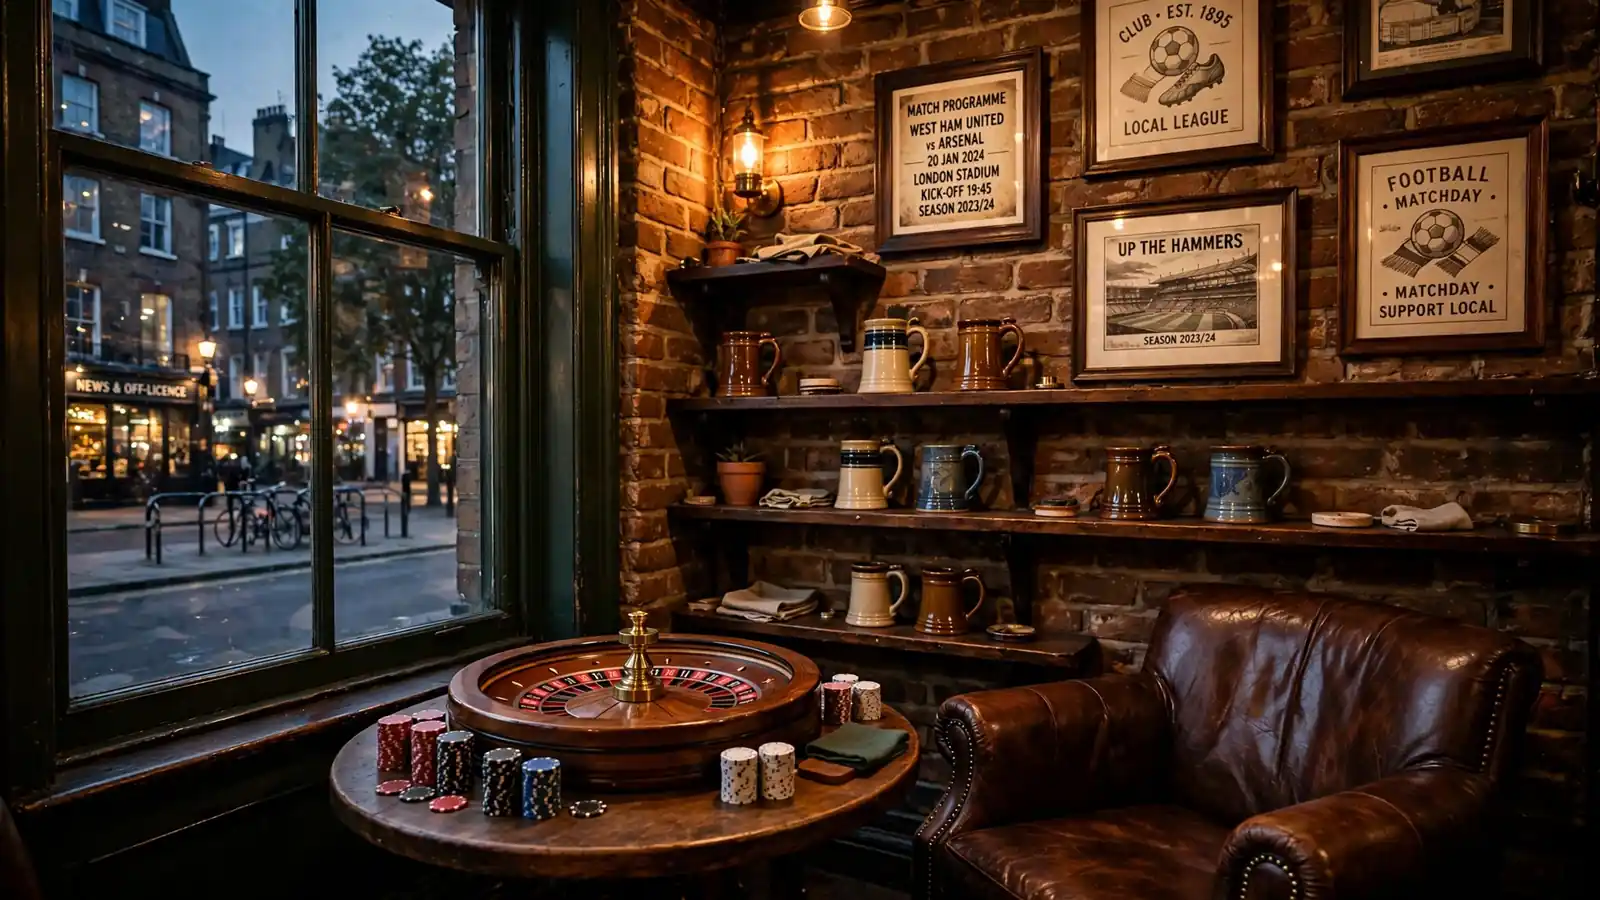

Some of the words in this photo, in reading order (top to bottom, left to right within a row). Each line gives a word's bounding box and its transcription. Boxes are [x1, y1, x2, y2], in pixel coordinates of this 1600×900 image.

[1119, 13, 1152, 43] CLUB
[1168, 4, 1194, 19] EST.
[1200, 5, 1233, 28] 1895
[908, 101, 939, 117] MATCH
[943, 92, 1006, 112] PROGRAMME
[910, 122, 936, 136] WEST
[940, 119, 962, 132] HAM
[967, 113, 1004, 129] UNITED
[1125, 117, 1167, 136] LOCAL
[1174, 109, 1228, 129] LEAGUE
[926, 142, 935, 150] vs
[939, 132, 984, 149] ARSENAL
[928, 155, 938, 167] 20
[941, 152, 958, 165] JAN
[962, 150, 984, 163] 2024
[914, 171, 953, 185] LONDON
[957, 165, 999, 180] STADIUM
[1387, 166, 1489, 192] FOOTBALL
[921, 186, 964, 201] KICK-OFF
[968, 183, 991, 196] 19:45
[1395, 189, 1482, 209] MATCHDAY
[919, 203, 954, 216] SEASON
[958, 198, 994, 213] 2023/24
[1119, 242, 1135, 256] UP
[1140, 240, 1166, 254] THE
[1172, 233, 1243, 252] HAMMERS
[1396, 282, 1480, 299] MATCHDAY
[1380, 303, 1444, 318] SUPPORT
[1451, 300, 1497, 315] LOCAL
[1144, 334, 1177, 345] SEASON
[1180, 333, 1215, 344] 2023/24
[76, 379, 110, 393] NEWS
[113, 383, 120, 393] &
[124, 383, 187, 397] OFF-LICENCE
